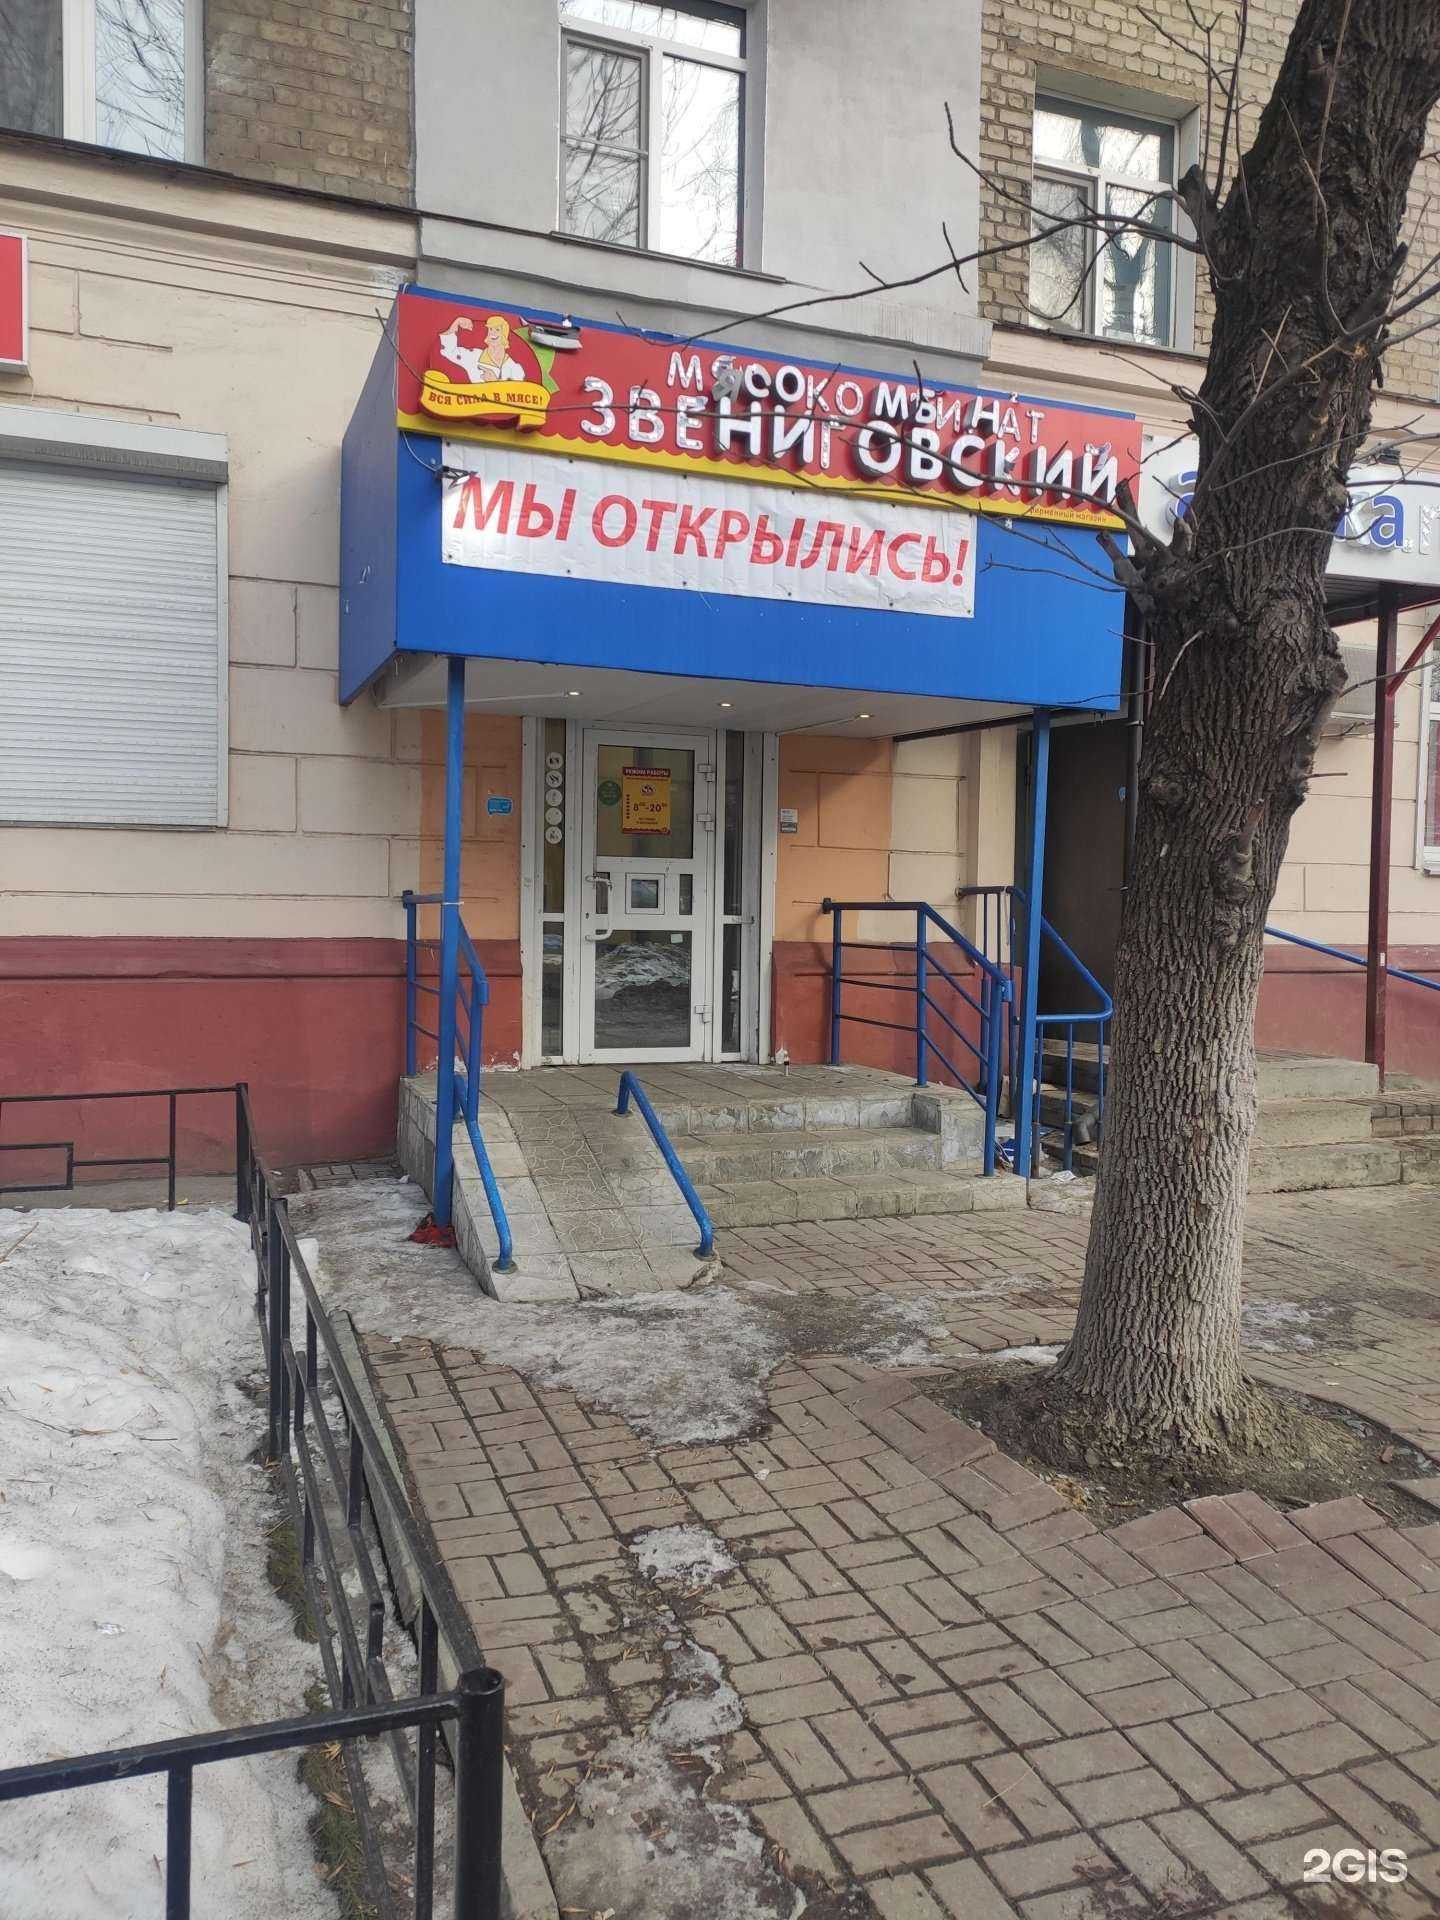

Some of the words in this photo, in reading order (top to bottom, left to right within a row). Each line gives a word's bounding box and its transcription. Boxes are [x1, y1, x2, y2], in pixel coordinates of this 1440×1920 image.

[428, 391, 451, 405] ВСЯ
[456, 393, 487, 405] СИЛА
[493, 392, 501, 402] В
[506, 392, 543, 406] МЯСЕ!
[580, 375, 1118, 504] ЗВЕНИГОВСКИЙ
[667, 350, 1045, 444] МЯСОКОМБИНАТ
[453, 472, 577, 541] МЫ
[591, 494, 969, 588] ОТКРЫЛИСЬ!
